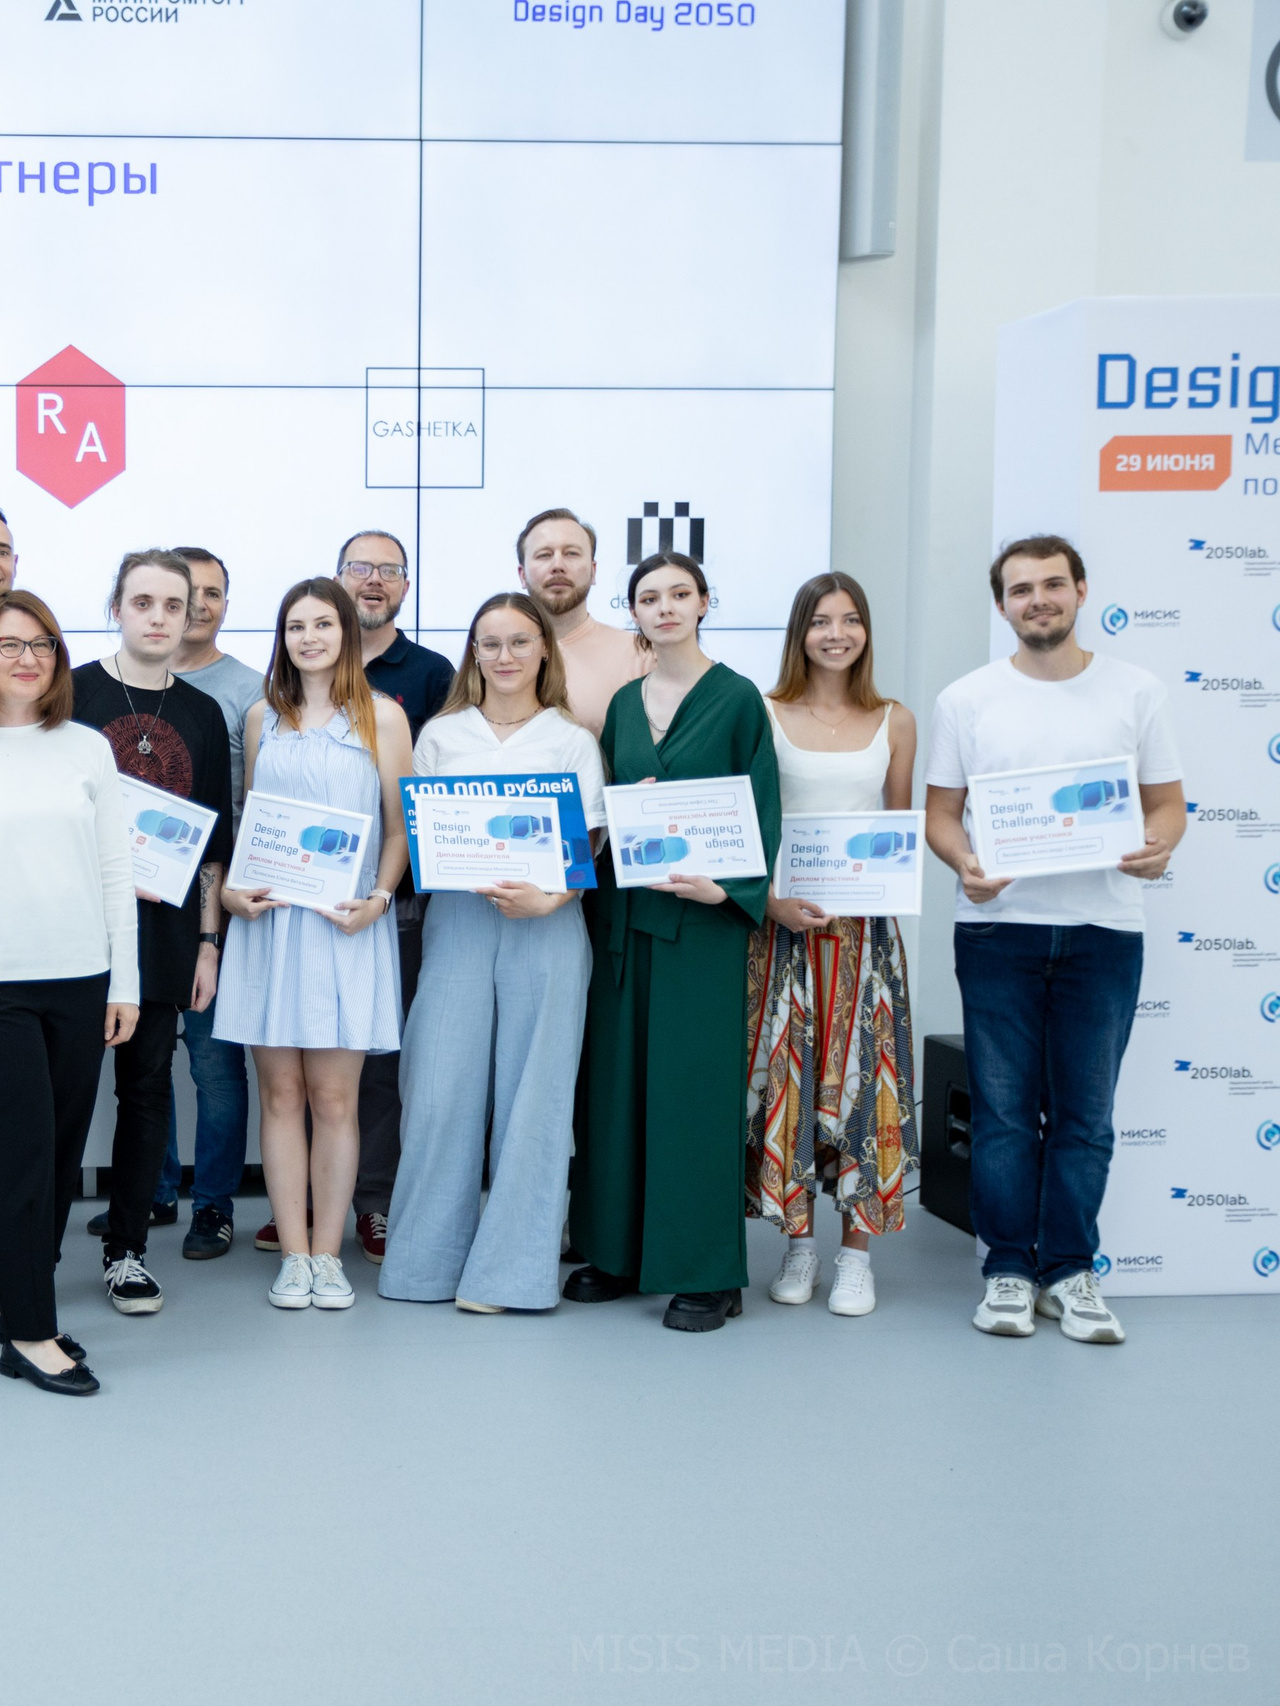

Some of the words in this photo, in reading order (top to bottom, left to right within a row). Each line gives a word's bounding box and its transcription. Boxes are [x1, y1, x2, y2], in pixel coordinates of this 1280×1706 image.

[92, 6, 179, 23] РОССИИ
[513, 0, 603, 29] Design
[616, 0, 664, 31] Day
[674, 3, 755, 26] 2050
[1096, 353, 1280, 424] Desig
[372, 420, 478, 438] GASHETKA
[1116, 454, 1141, 472] 29
[1146, 453, 1215, 471] ИЮНЯ
[1205, 546, 1269, 559] 2050lab.
[1134, 609, 1181, 620] МИСИС
[1201, 678, 1264, 691] 2050lab.
[504, 778, 574, 798] рублей
[990, 801, 1033, 815] Design
[1197, 808, 1260, 822] 2050lab.
[433, 821, 471, 834] Design
[992, 814, 1056, 830] Challenge
[254, 823, 287, 839] Design
[684, 824, 742, 836] Challenge
[251, 836, 299, 856] Challenge
[434, 835, 490, 848] Challenge
[705, 838, 745, 849] Design
[791, 843, 830, 855] Design
[790, 857, 847, 869] Challenge
[1194, 938, 1257, 951] 2050lab.
[1136, 1000, 1171, 1011] ИСИС
[1190, 1066, 1253, 1079] 2050lab.
[1120, 1128, 1167, 1139] МИСИС
[1187, 1193, 1249, 1207] 2050lab.
[1117, 1255, 1163, 1266] МИСИС
